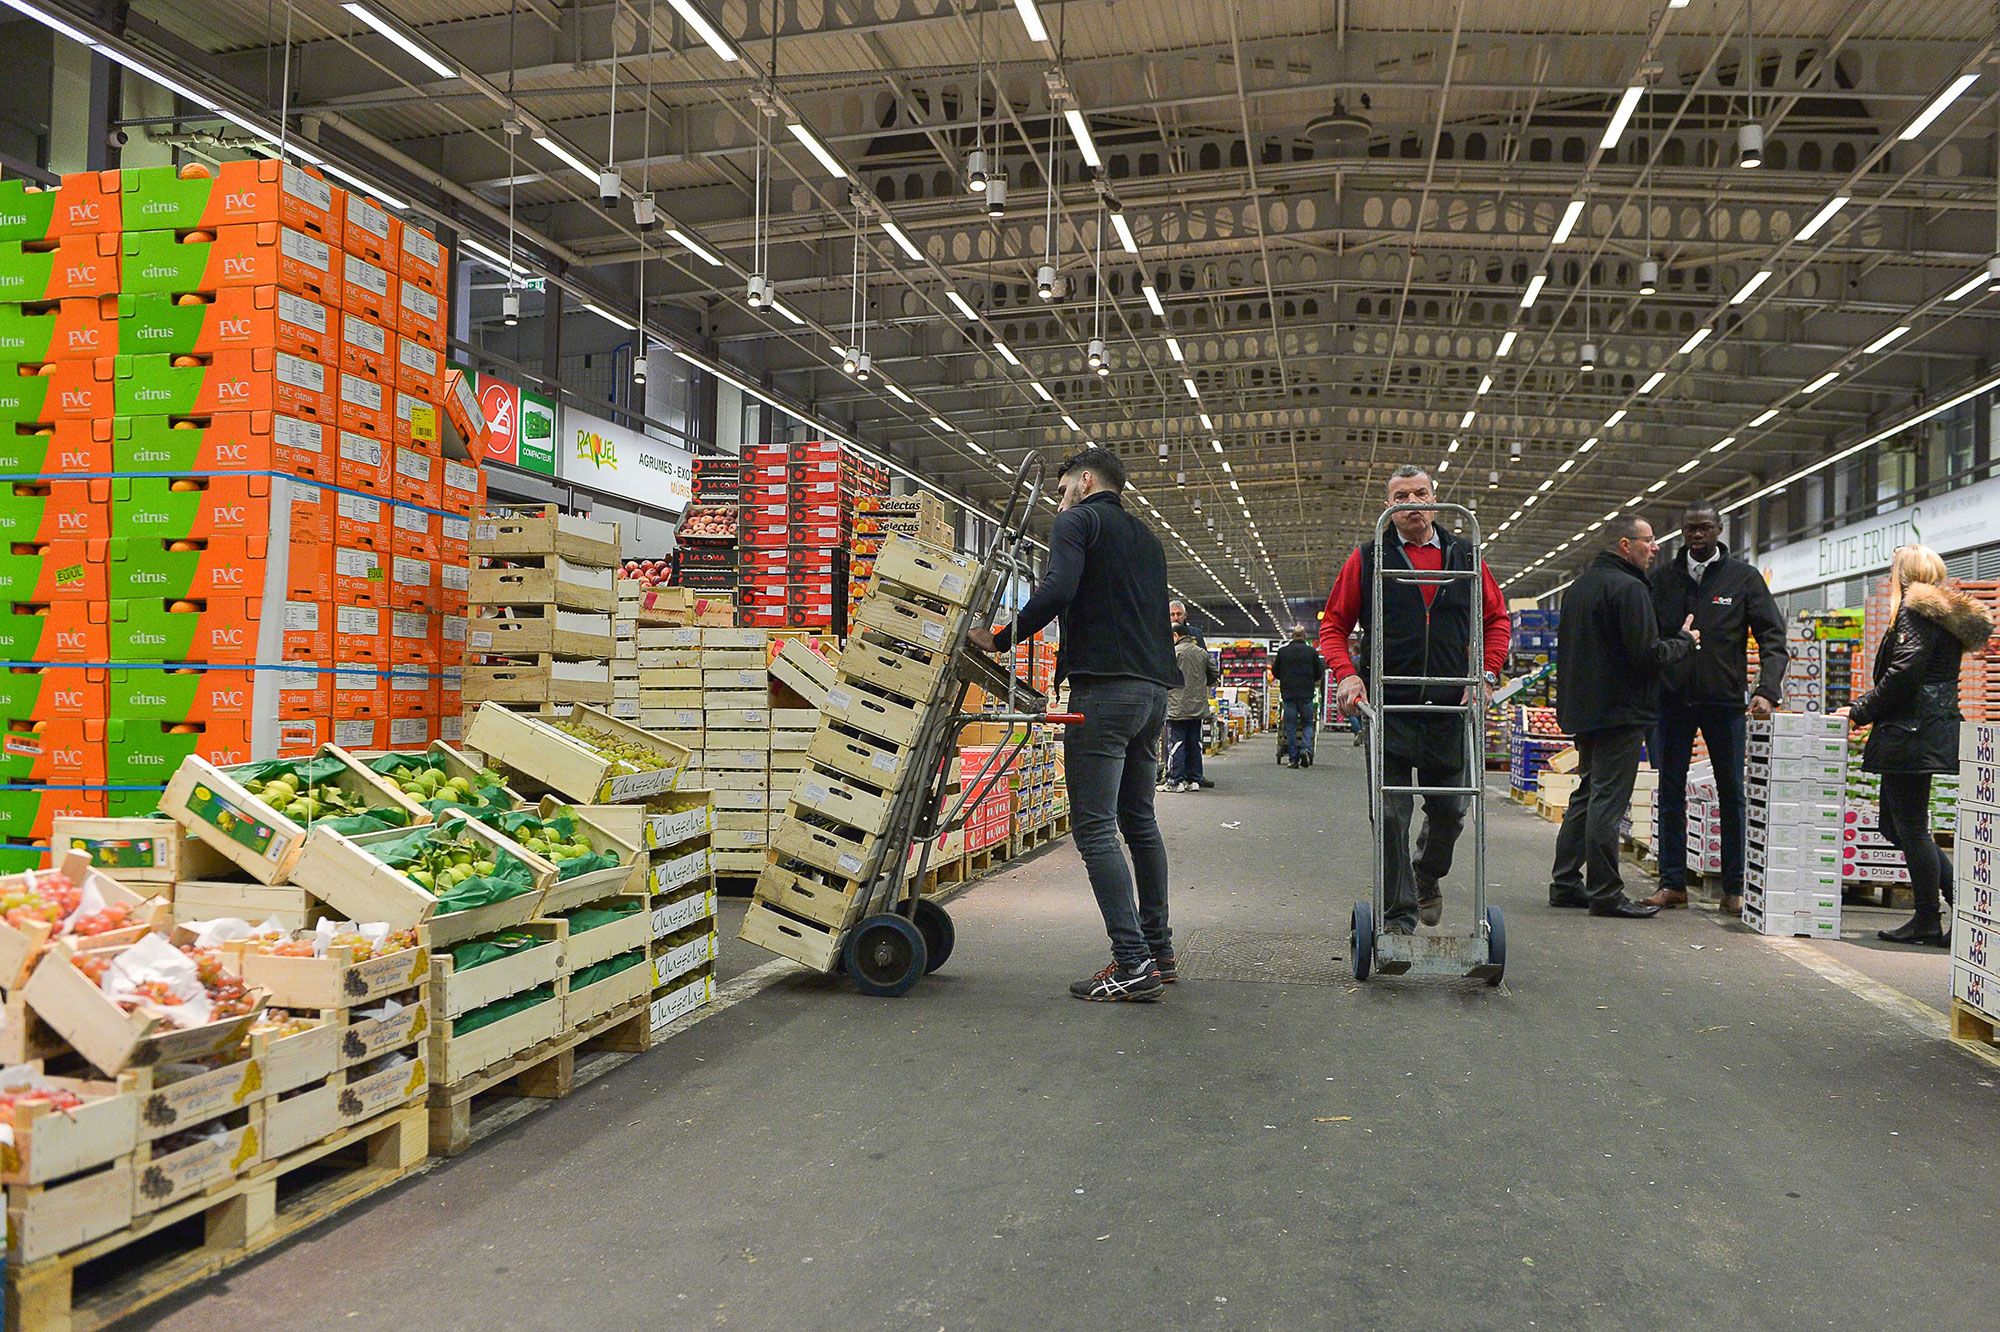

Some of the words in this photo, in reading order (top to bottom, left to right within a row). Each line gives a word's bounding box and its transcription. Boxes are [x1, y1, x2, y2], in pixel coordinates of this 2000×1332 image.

[142, 201, 179, 214] citrus
[225, 193, 255, 209] FVC
[0, 213, 26, 225] itrus
[69, 205, 99, 221] FVC
[142, 265, 178, 278] citrus
[224, 258, 254, 274] FVC
[0, 275, 24, 286] trus
[67, 267, 96, 284] FVC
[137, 326, 173, 339] citrus
[219, 320, 250, 336] FVC
[0, 336, 25, 347] trus
[69, 330, 98, 346] FVC
[135, 388, 171, 401] citrus
[218, 383, 249, 398] FVC
[62, 392, 91, 408] FVC
[61, 452, 90, 468] FVC
[133, 450, 171, 462] citrus
[216, 445, 249, 461] FVC
[522, 447, 552, 463] COMPACTEUR
[639, 453, 672, 475] AGRUMES
[677, 466, 691, 480] EXO
[879, 500, 921, 510] Selectas
[58, 514, 88, 528] FVC
[132, 510, 169, 523] citrus
[214, 507, 245, 522] FVC
[878, 522, 920, 532] Selectas
[1819, 536, 1857, 577] ELITE
[130, 571, 167, 583] citrus
[212, 568, 243, 584] FVC
[57, 633, 85, 648] FVC
[130, 631, 166, 644] citrus
[212, 629, 242, 644] FVC
[55, 692, 83, 706] FVC
[130, 693, 166, 706] citrus
[212, 691, 242, 706] FVC
[1977, 727, 1994, 743] TOI
[53, 750, 82, 765] FVC
[128, 752, 164, 764] citrus
[211, 751, 240, 763] FVC
[1977, 746, 1994, 762] MOI
[1977, 767, 1994, 783] TOI
[612, 772, 672, 796] Chasselas
[1976, 785, 1994, 802] MOI
[656, 812, 704, 840] Chasselas
[1974, 825, 1992, 843] MOI
[1974, 847, 1991, 865] TOI
[658, 855, 705, 887] Chasselas
[1973, 866, 1991, 884] MOI
[1974, 887, 1992, 906] TOI
[652, 899, 704, 933] Chasselas
[1971, 928, 1987, 948] TOI
[657, 942, 707, 978] Chasselas
[1969, 946, 1986, 967] MOI
[1967, 986, 1984, 1008] MOI
[650, 986, 704, 1025] Chasselas
